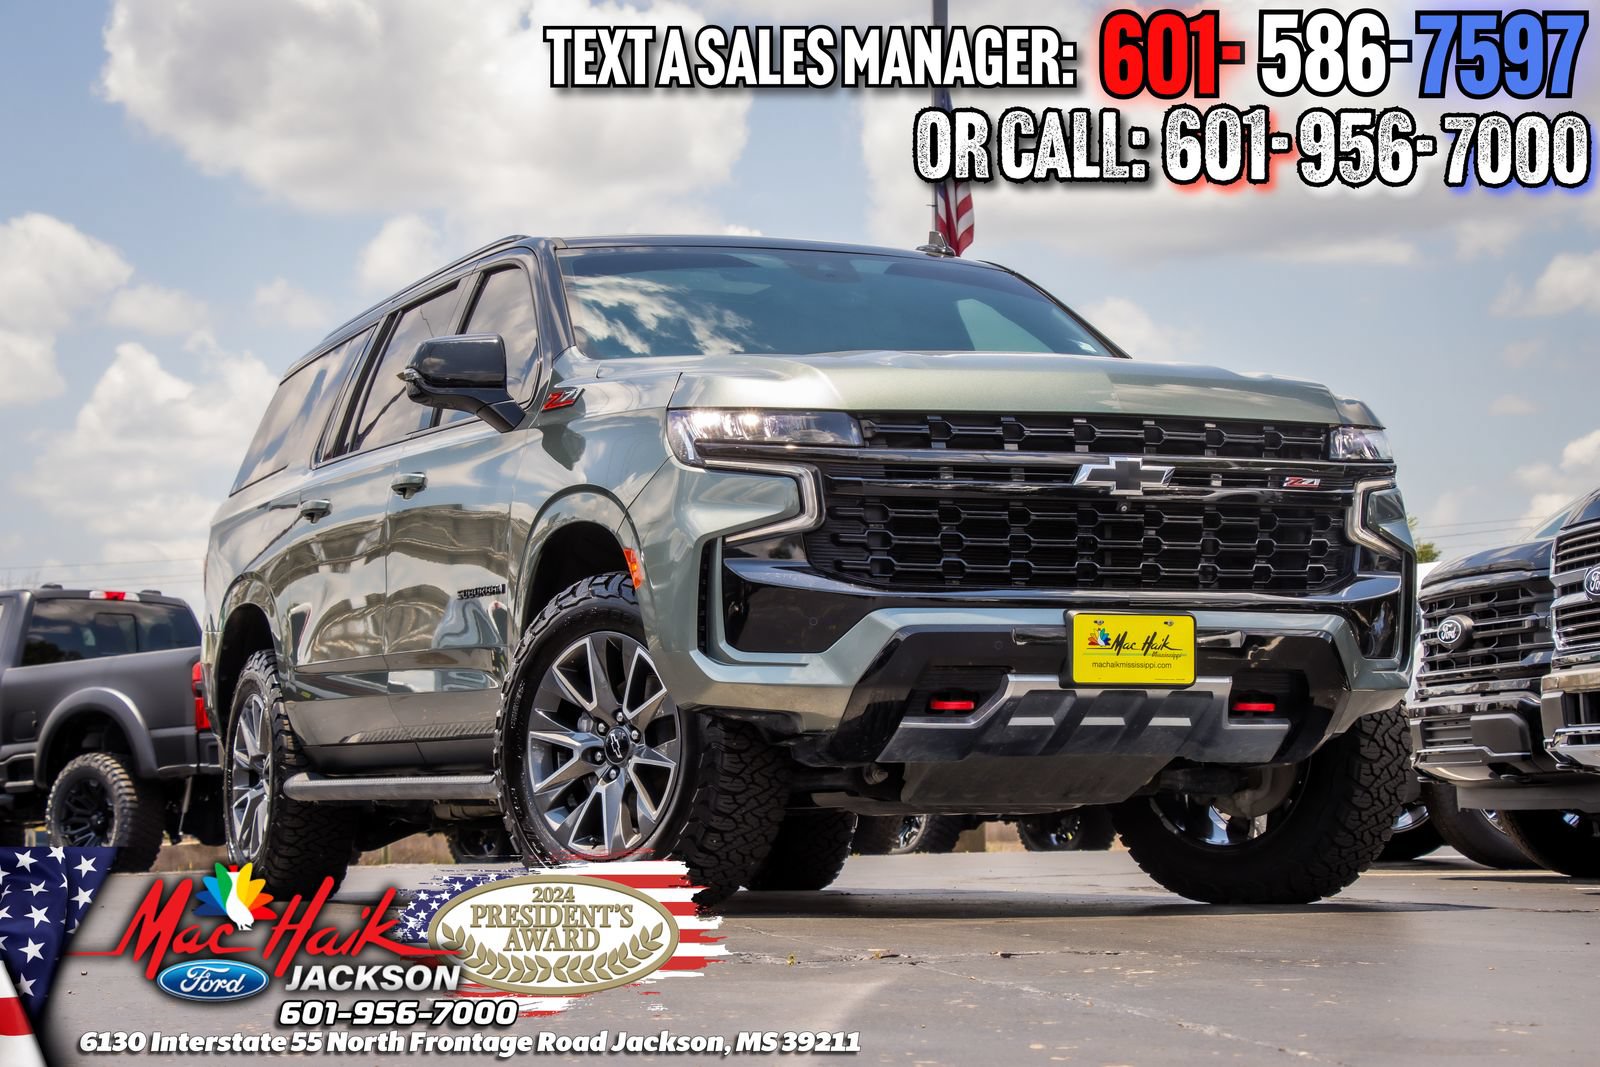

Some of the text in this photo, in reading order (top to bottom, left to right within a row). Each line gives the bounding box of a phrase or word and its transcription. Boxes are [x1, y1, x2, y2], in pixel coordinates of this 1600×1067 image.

[1110, 631, 1176, 656] Mac Haik
[1092, 661, 1172, 670] machaikmississippi.com
